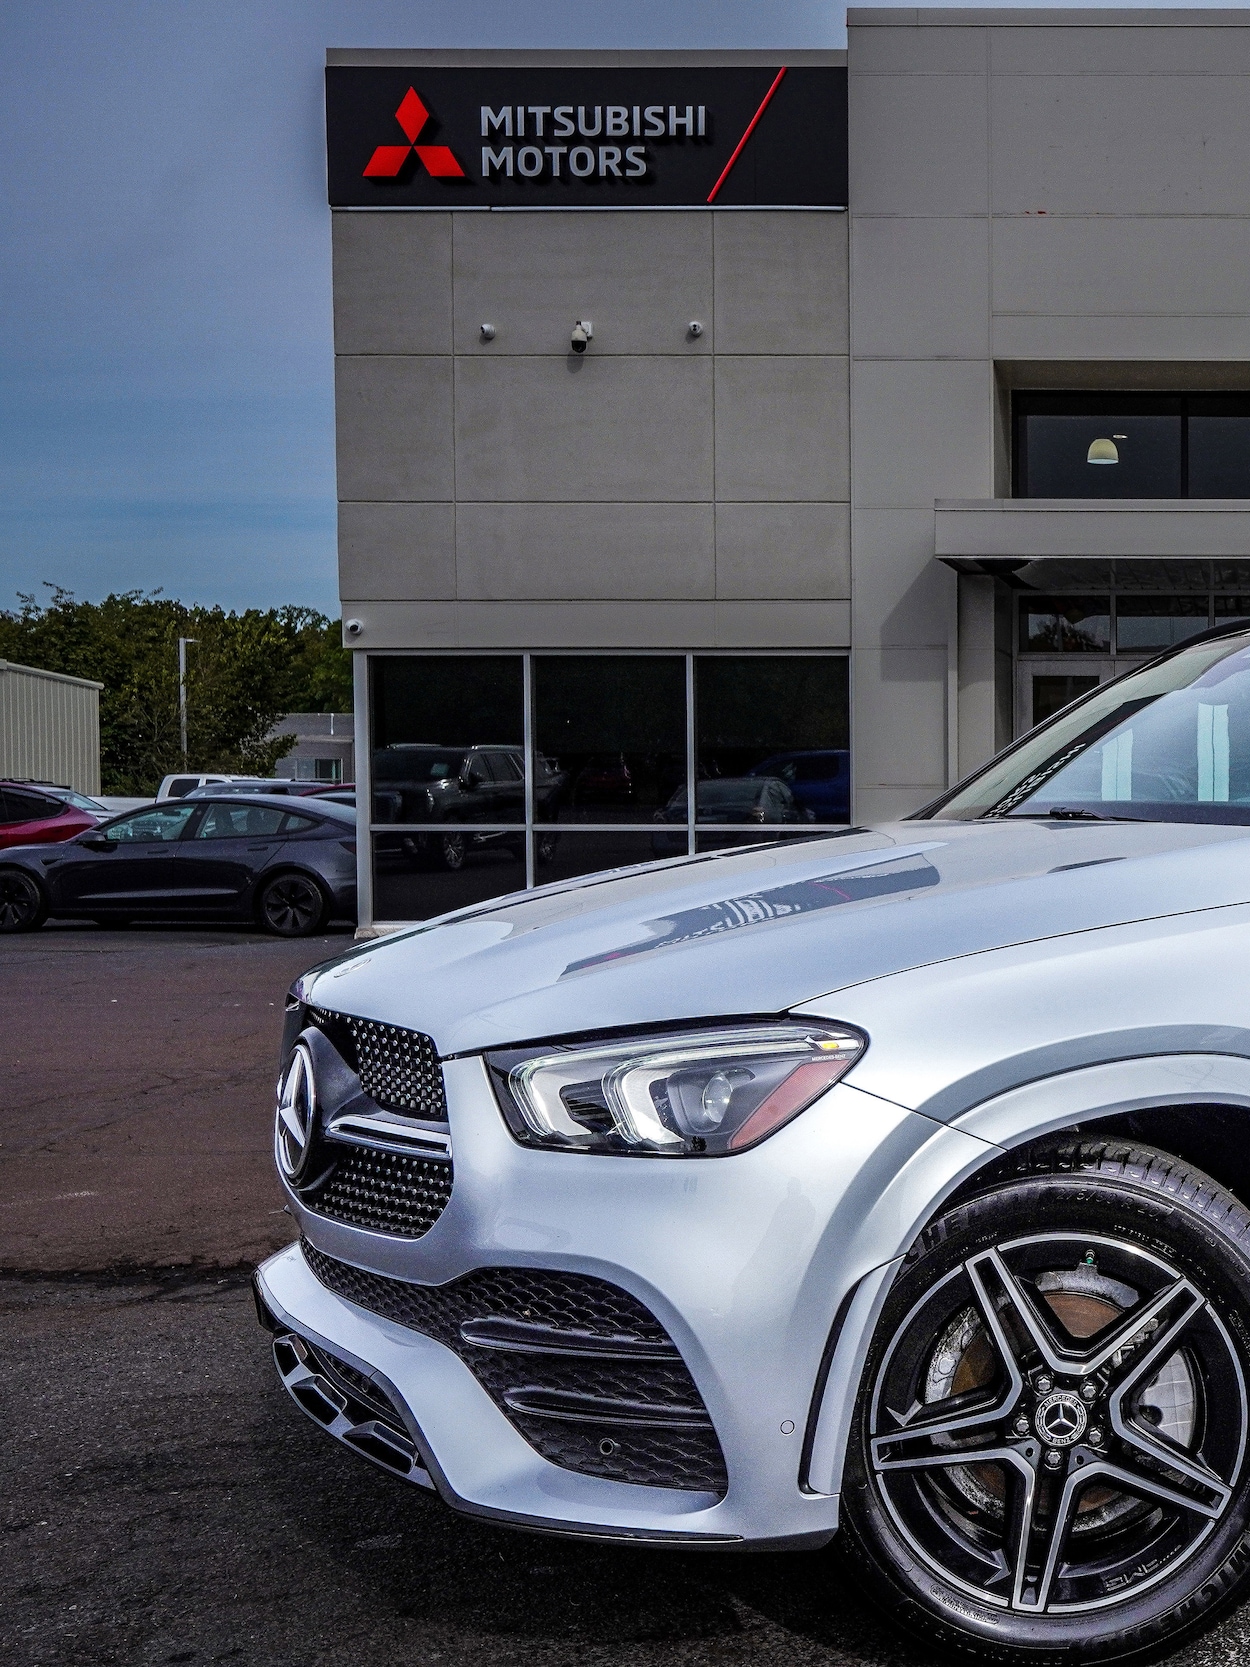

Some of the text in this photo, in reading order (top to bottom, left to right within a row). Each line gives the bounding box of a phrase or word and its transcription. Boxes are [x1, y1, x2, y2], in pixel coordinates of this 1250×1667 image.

[480, 105, 706, 137] MITSUBISHI
[480, 146, 648, 177] MOTORS
[1052, 1436, 1071, 1444] BENZ
